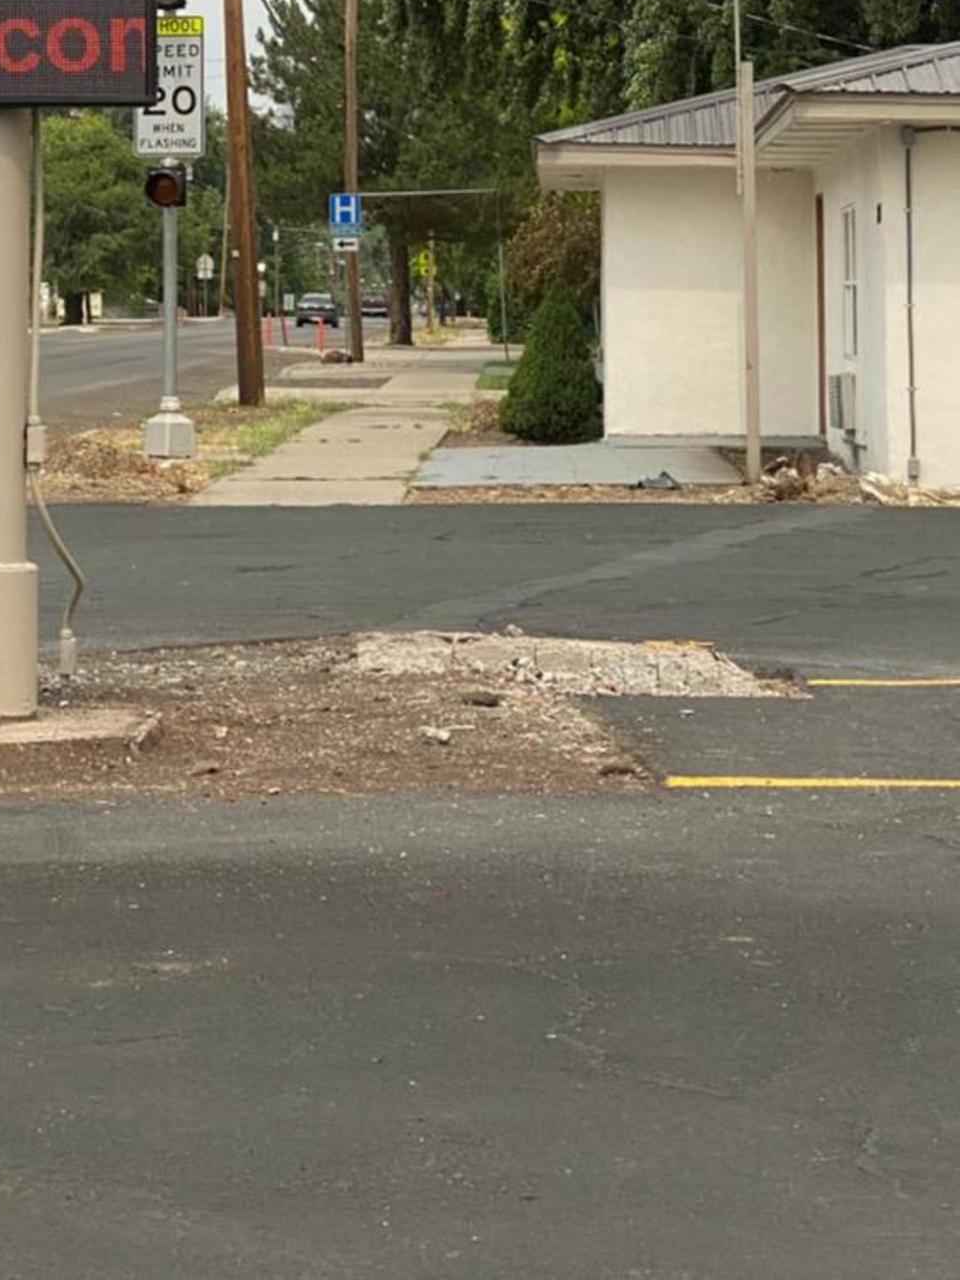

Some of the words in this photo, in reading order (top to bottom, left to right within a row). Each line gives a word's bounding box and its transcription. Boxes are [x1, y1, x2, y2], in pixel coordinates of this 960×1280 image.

[159, 20, 199, 33] HOOL
[162, 64, 195, 78] MIT
[143, 85, 196, 115] 20
[152, 122, 185, 133] WHEN
[140, 137, 197, 150] FLASHING
[335, 195, 356, 224] H
